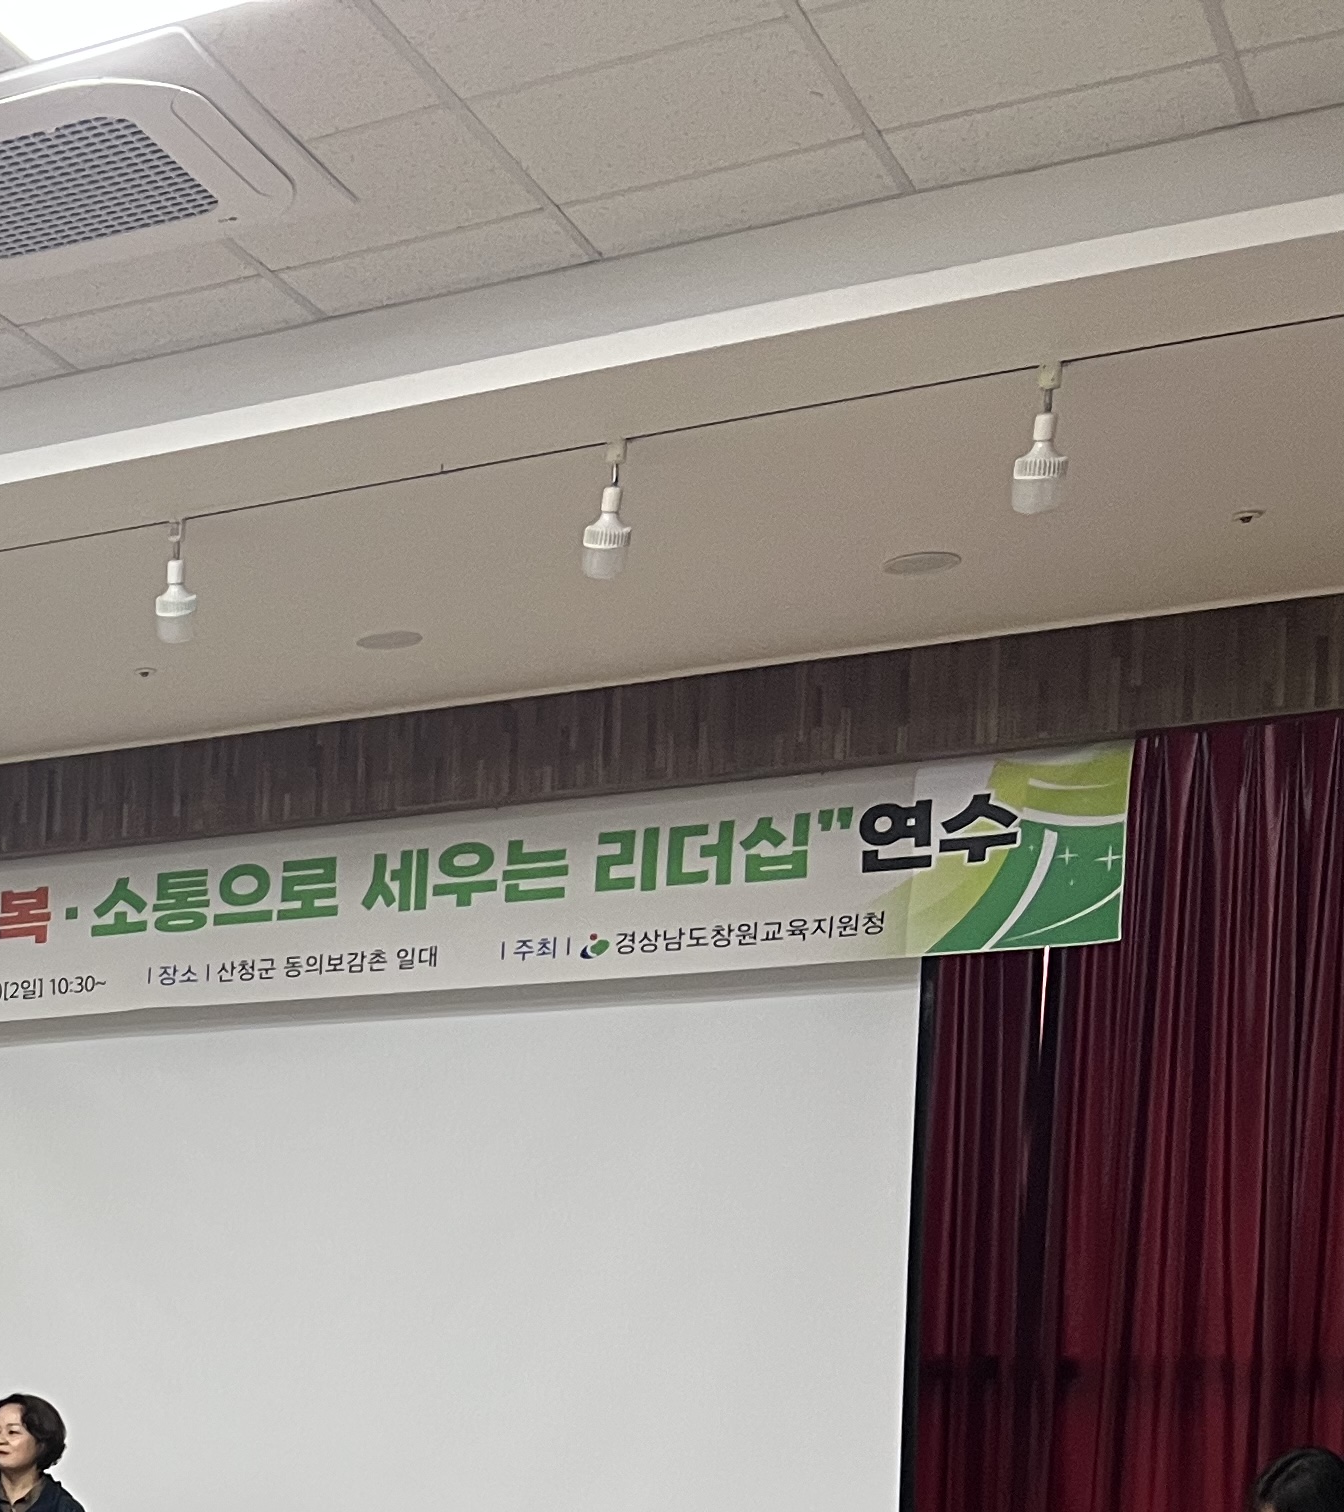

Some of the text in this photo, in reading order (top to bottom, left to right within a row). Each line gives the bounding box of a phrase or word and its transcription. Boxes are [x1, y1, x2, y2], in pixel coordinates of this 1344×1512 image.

[89, 855, 339, 939] 소통으로
[361, 837, 569, 914] 세우는
[615, 910, 886, 955] 경상남도창원교육지원청
[216, 957, 277, 983] 산청군
[283, 948, 388, 979] 동의보감촌
[396, 945, 439, 970] 일대
